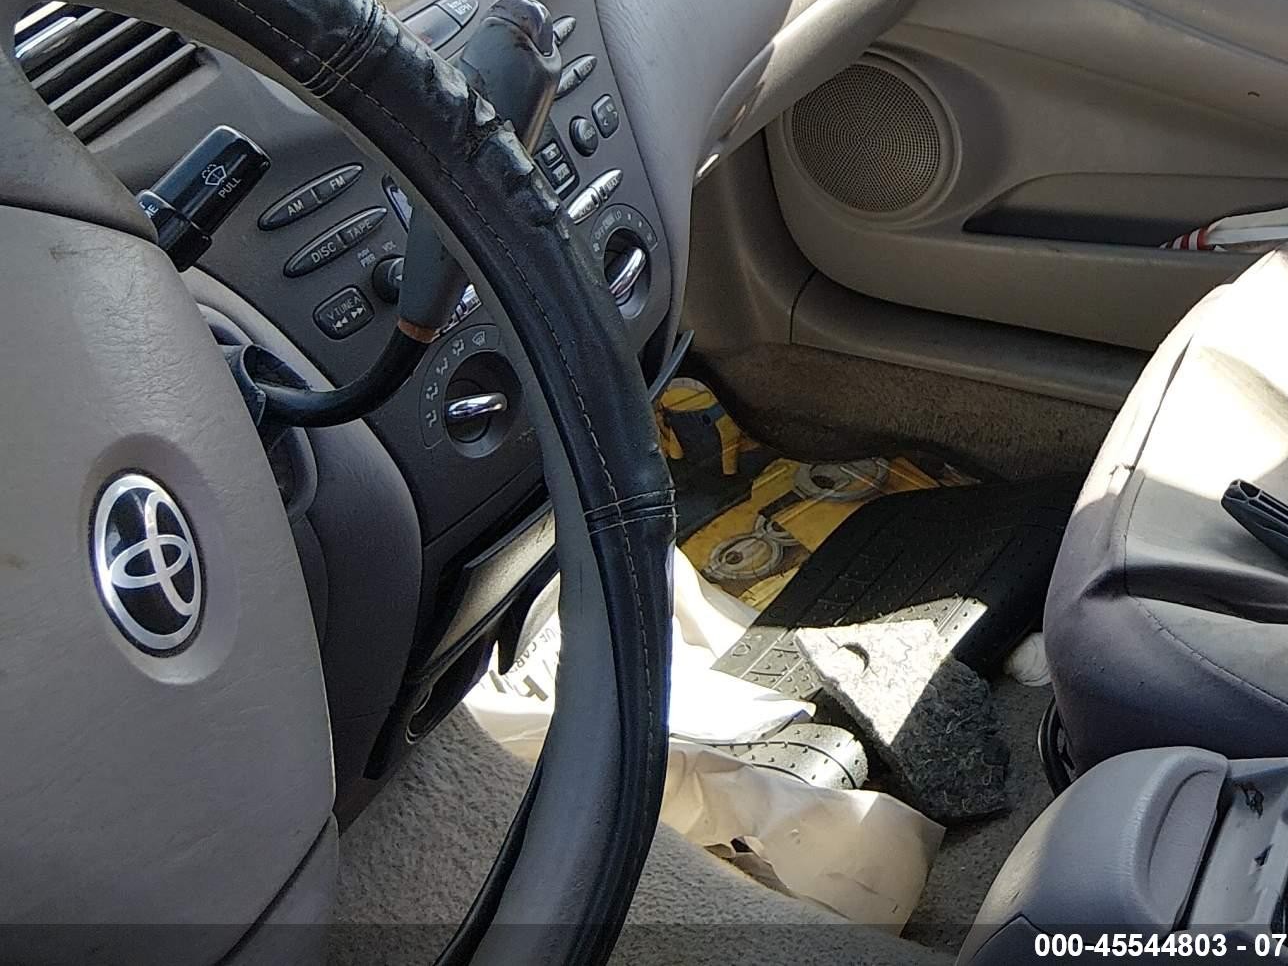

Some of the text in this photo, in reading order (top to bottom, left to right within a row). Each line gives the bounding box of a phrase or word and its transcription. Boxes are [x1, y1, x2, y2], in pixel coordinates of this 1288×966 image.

[218, 177, 242, 199] PULL
[329, 175, 346, 191] FM
[287, 199, 305, 217] AM
[347, 218, 373, 240] TAPE
[310, 241, 337, 264] DISC
[334, 297, 355, 317] TUNE
